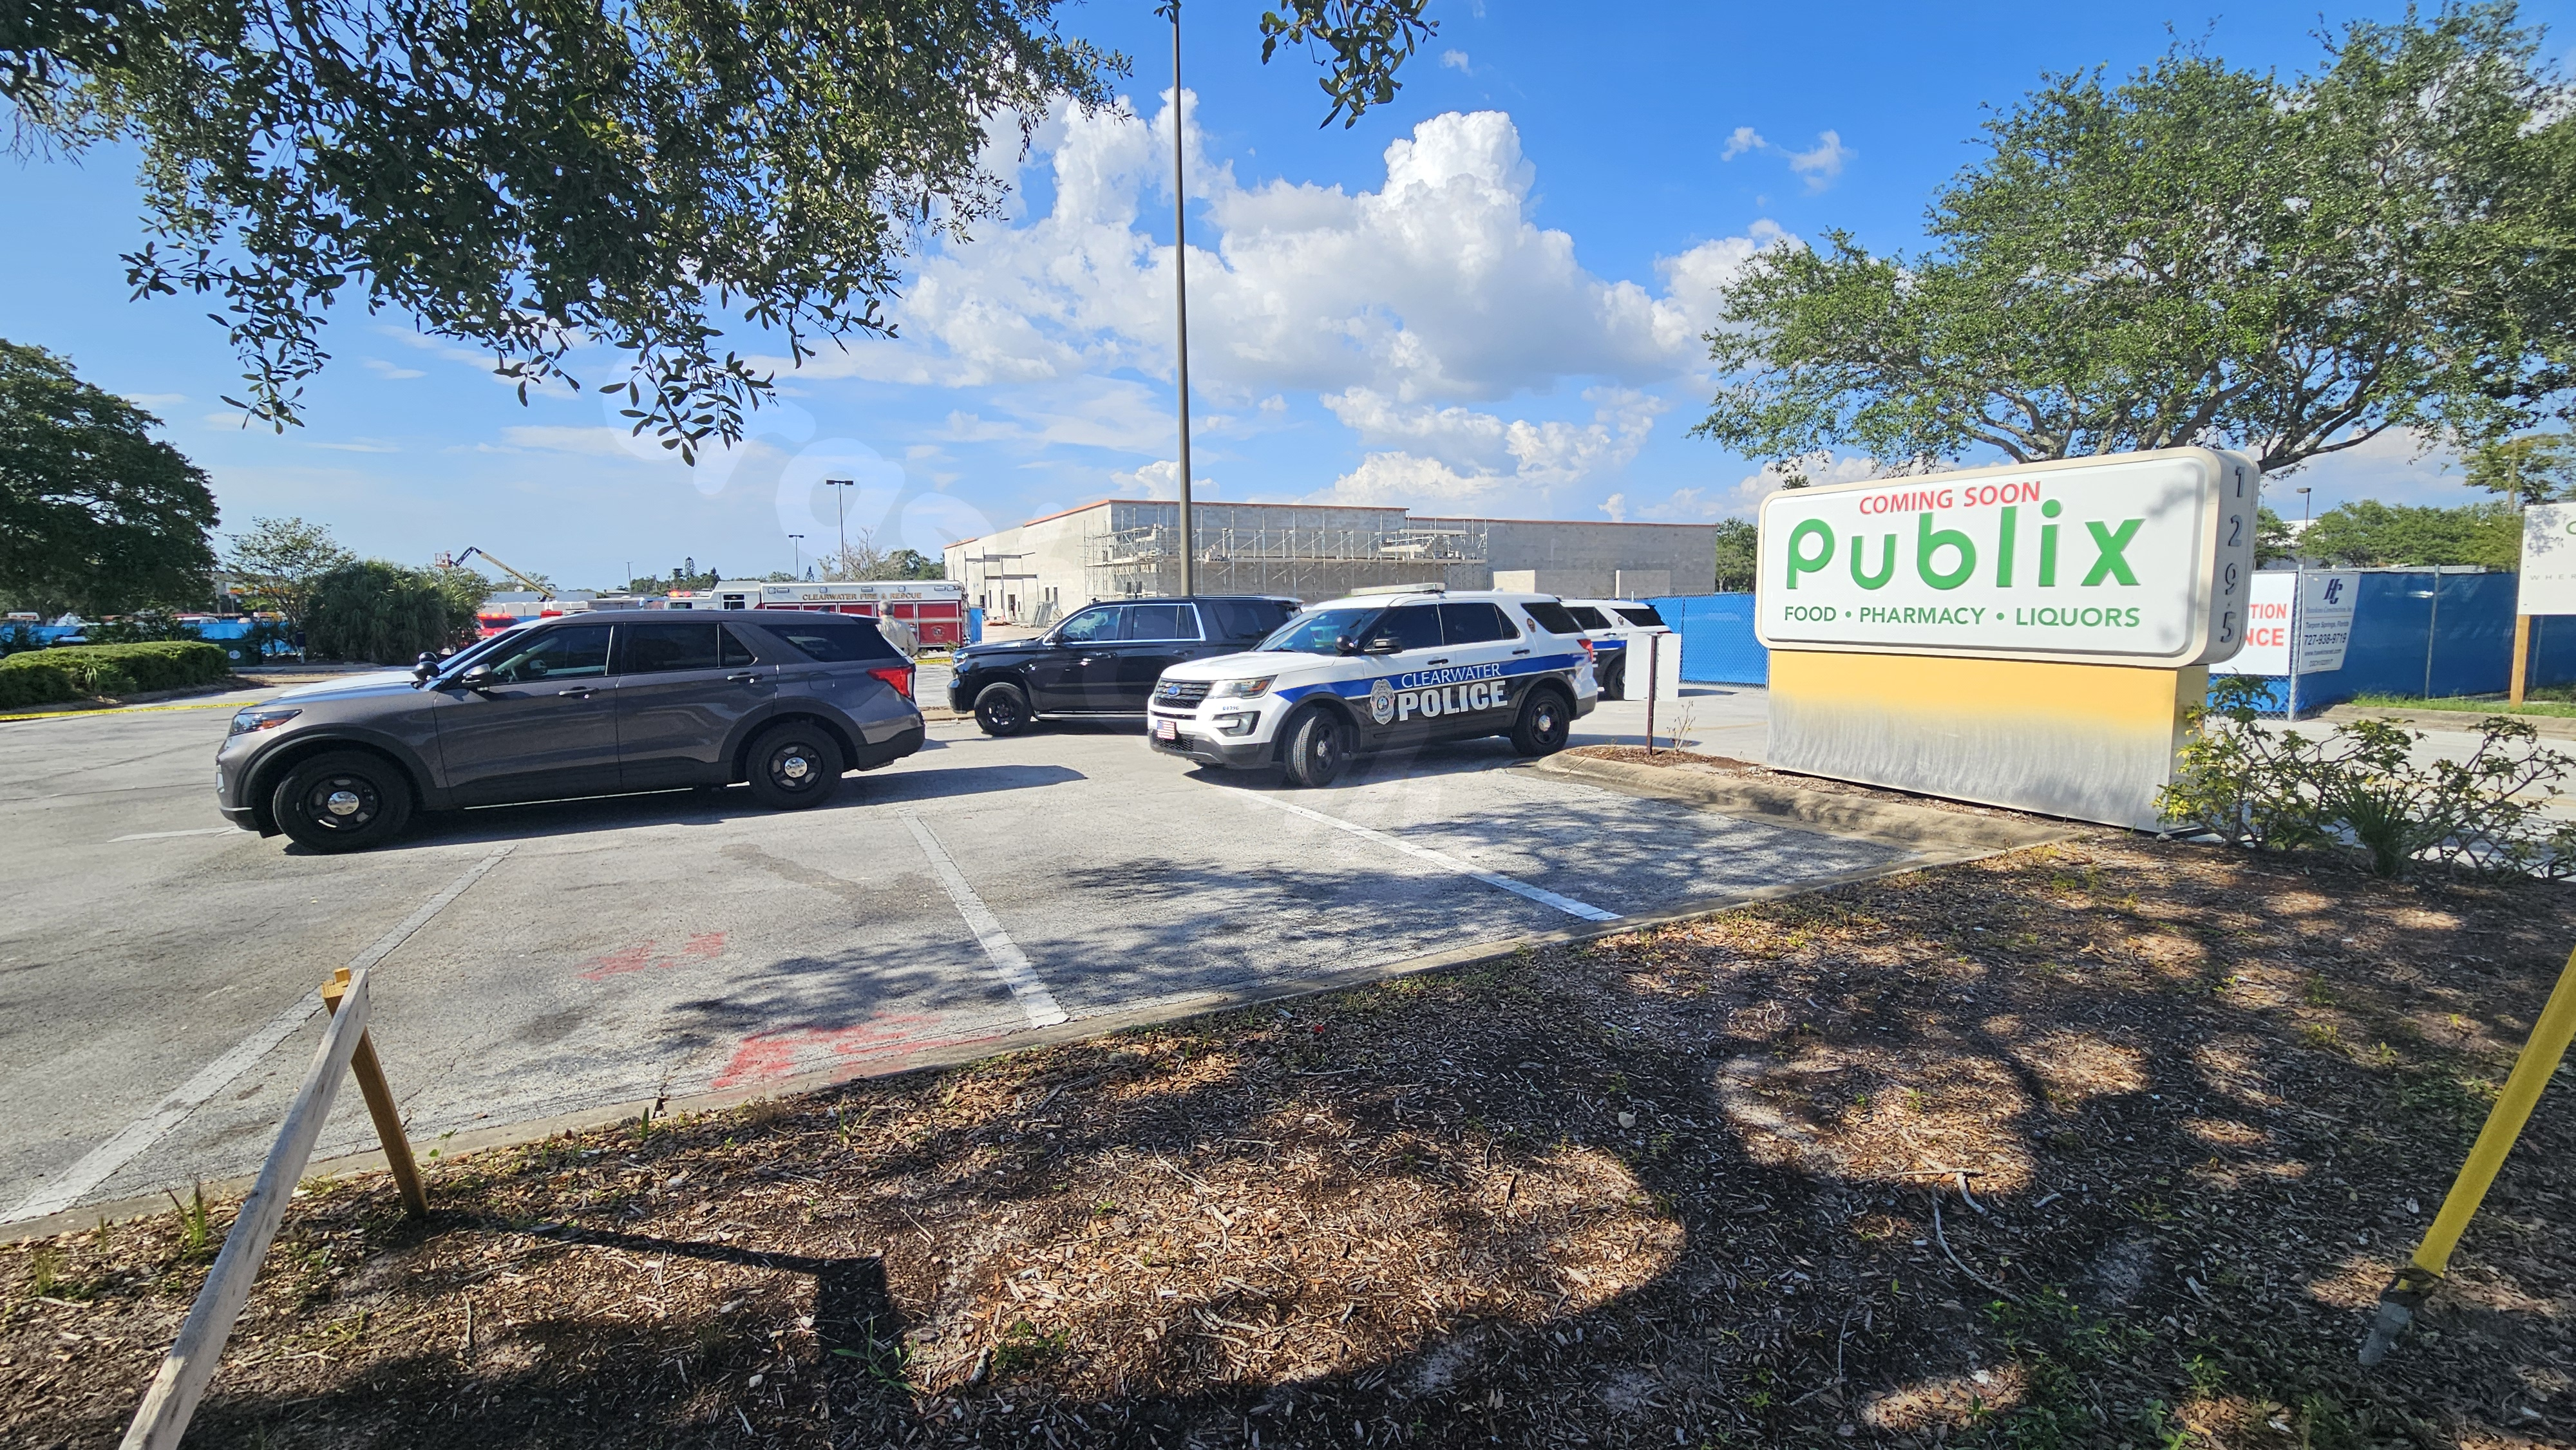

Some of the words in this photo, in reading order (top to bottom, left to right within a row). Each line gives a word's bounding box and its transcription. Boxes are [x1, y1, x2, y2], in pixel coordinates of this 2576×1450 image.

[1860, 489, 1953, 514] COMING
[1964, 481, 2040, 507] SOON
[2220, 464, 2246, 644] 1295
[1785, 606, 1837, 622] FOOD
[1860, 607, 1986, 625] PHARMACY
[2016, 607, 2141, 627] LIQUORS
[2304, 633, 2347, 645] 727-938-9719
[1401, 663, 1501, 688] CLEARWATER
[1398, 680, 1508, 721] POLICE
